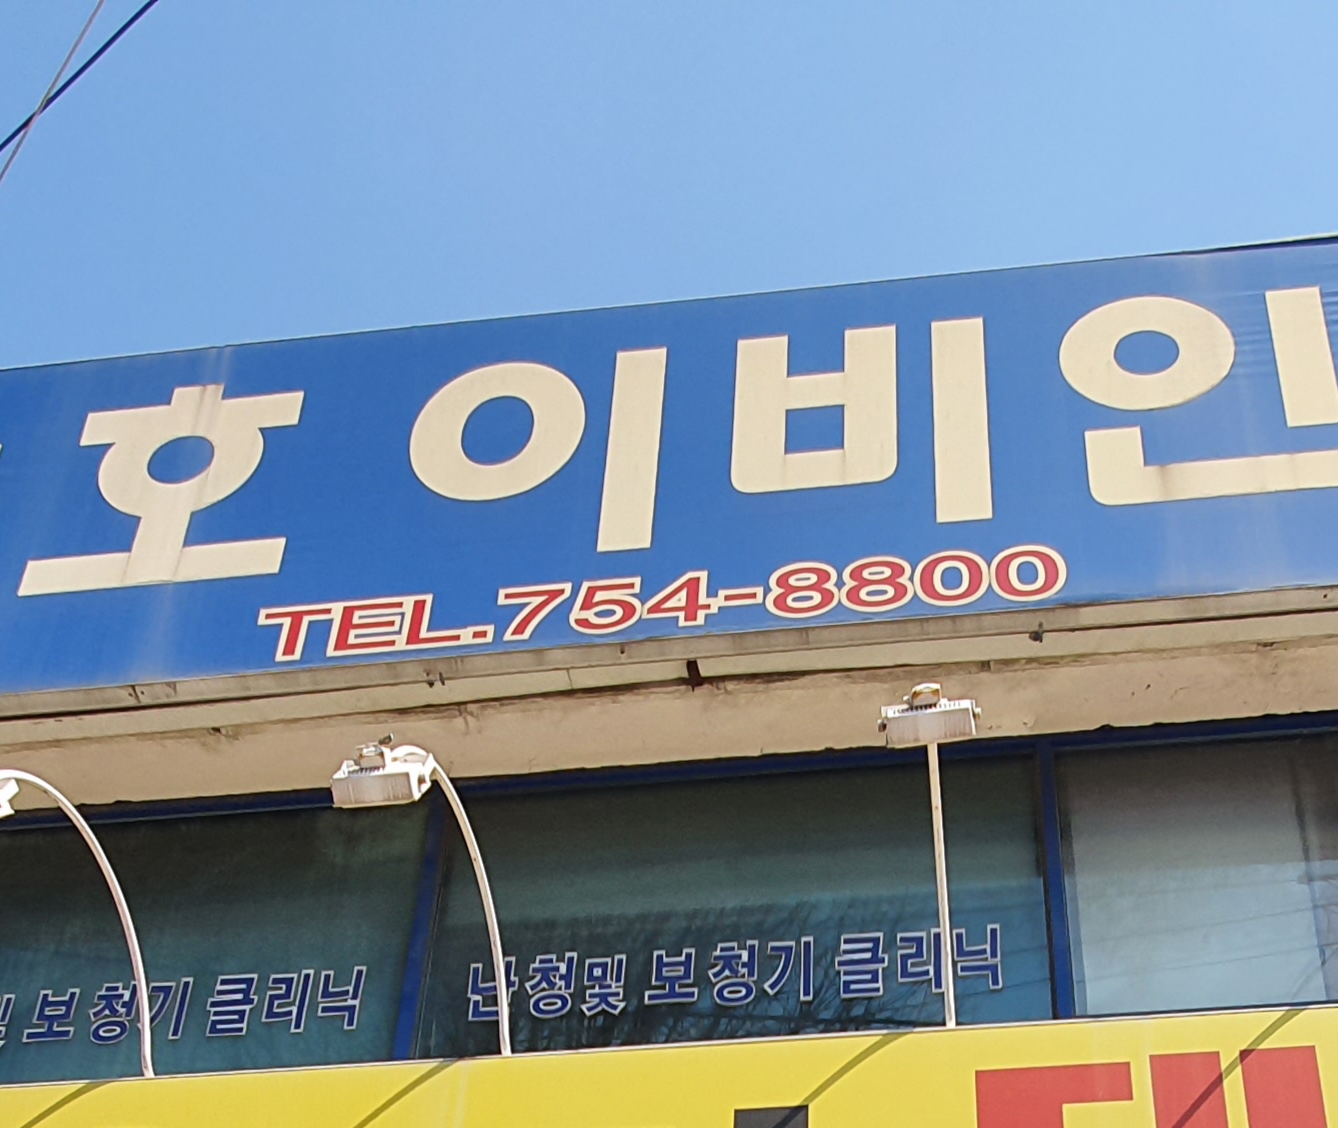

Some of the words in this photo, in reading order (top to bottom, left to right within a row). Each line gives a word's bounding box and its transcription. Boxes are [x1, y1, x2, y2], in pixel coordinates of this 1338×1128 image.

[257, 544, 1067, 663] TEL.754-8800
[22, 976, 194, 1045] 보청기
[206, 966, 367, 1037] 클리닉
[644, 936, 814, 1007] 보청기
[835, 923, 1002, 999] 클리닉
